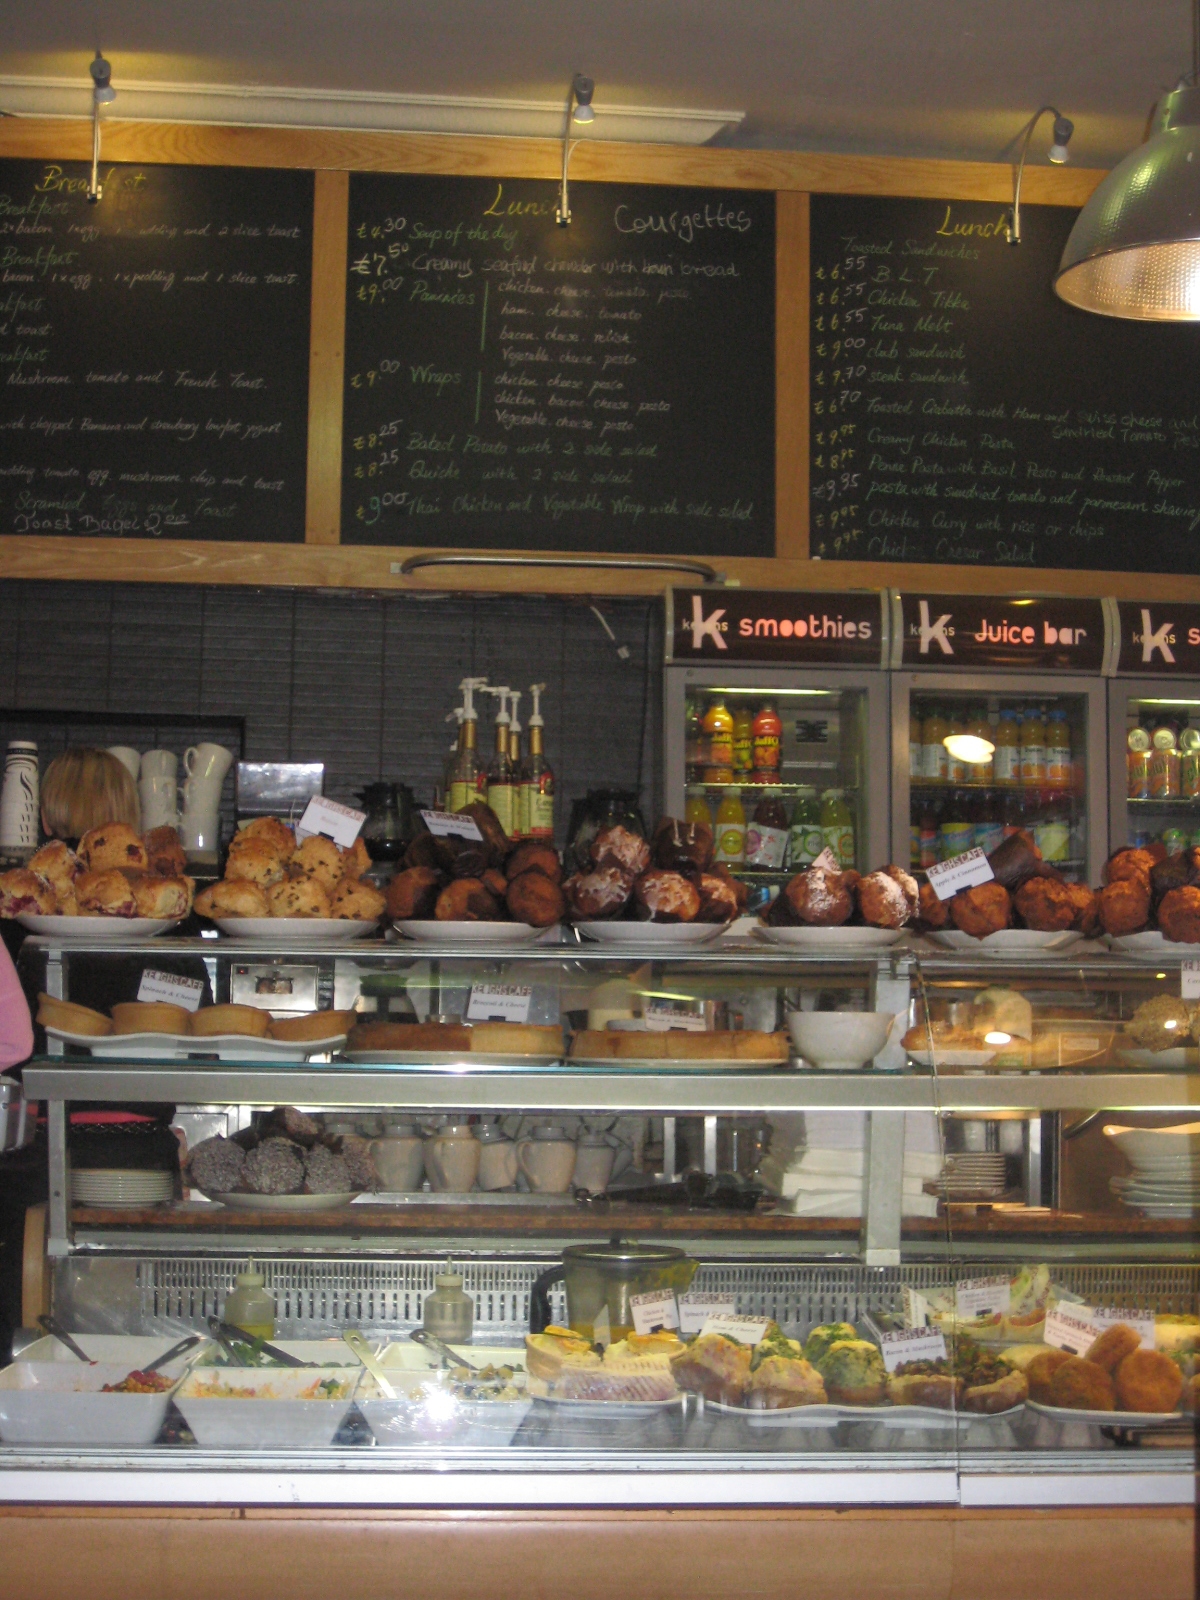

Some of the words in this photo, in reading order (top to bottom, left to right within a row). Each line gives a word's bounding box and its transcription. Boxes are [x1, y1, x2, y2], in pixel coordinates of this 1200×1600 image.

[35, 165, 146, 191] Breafst
[483, 183, 566, 215] Lunc
[614, 204, 751, 243] Courgettes
[410, 363, 462, 397] Wraps
[739, 614, 873, 640] smoothies
[975, 619, 1036, 645] Juice
[1044, 621, 1087, 645] bar
